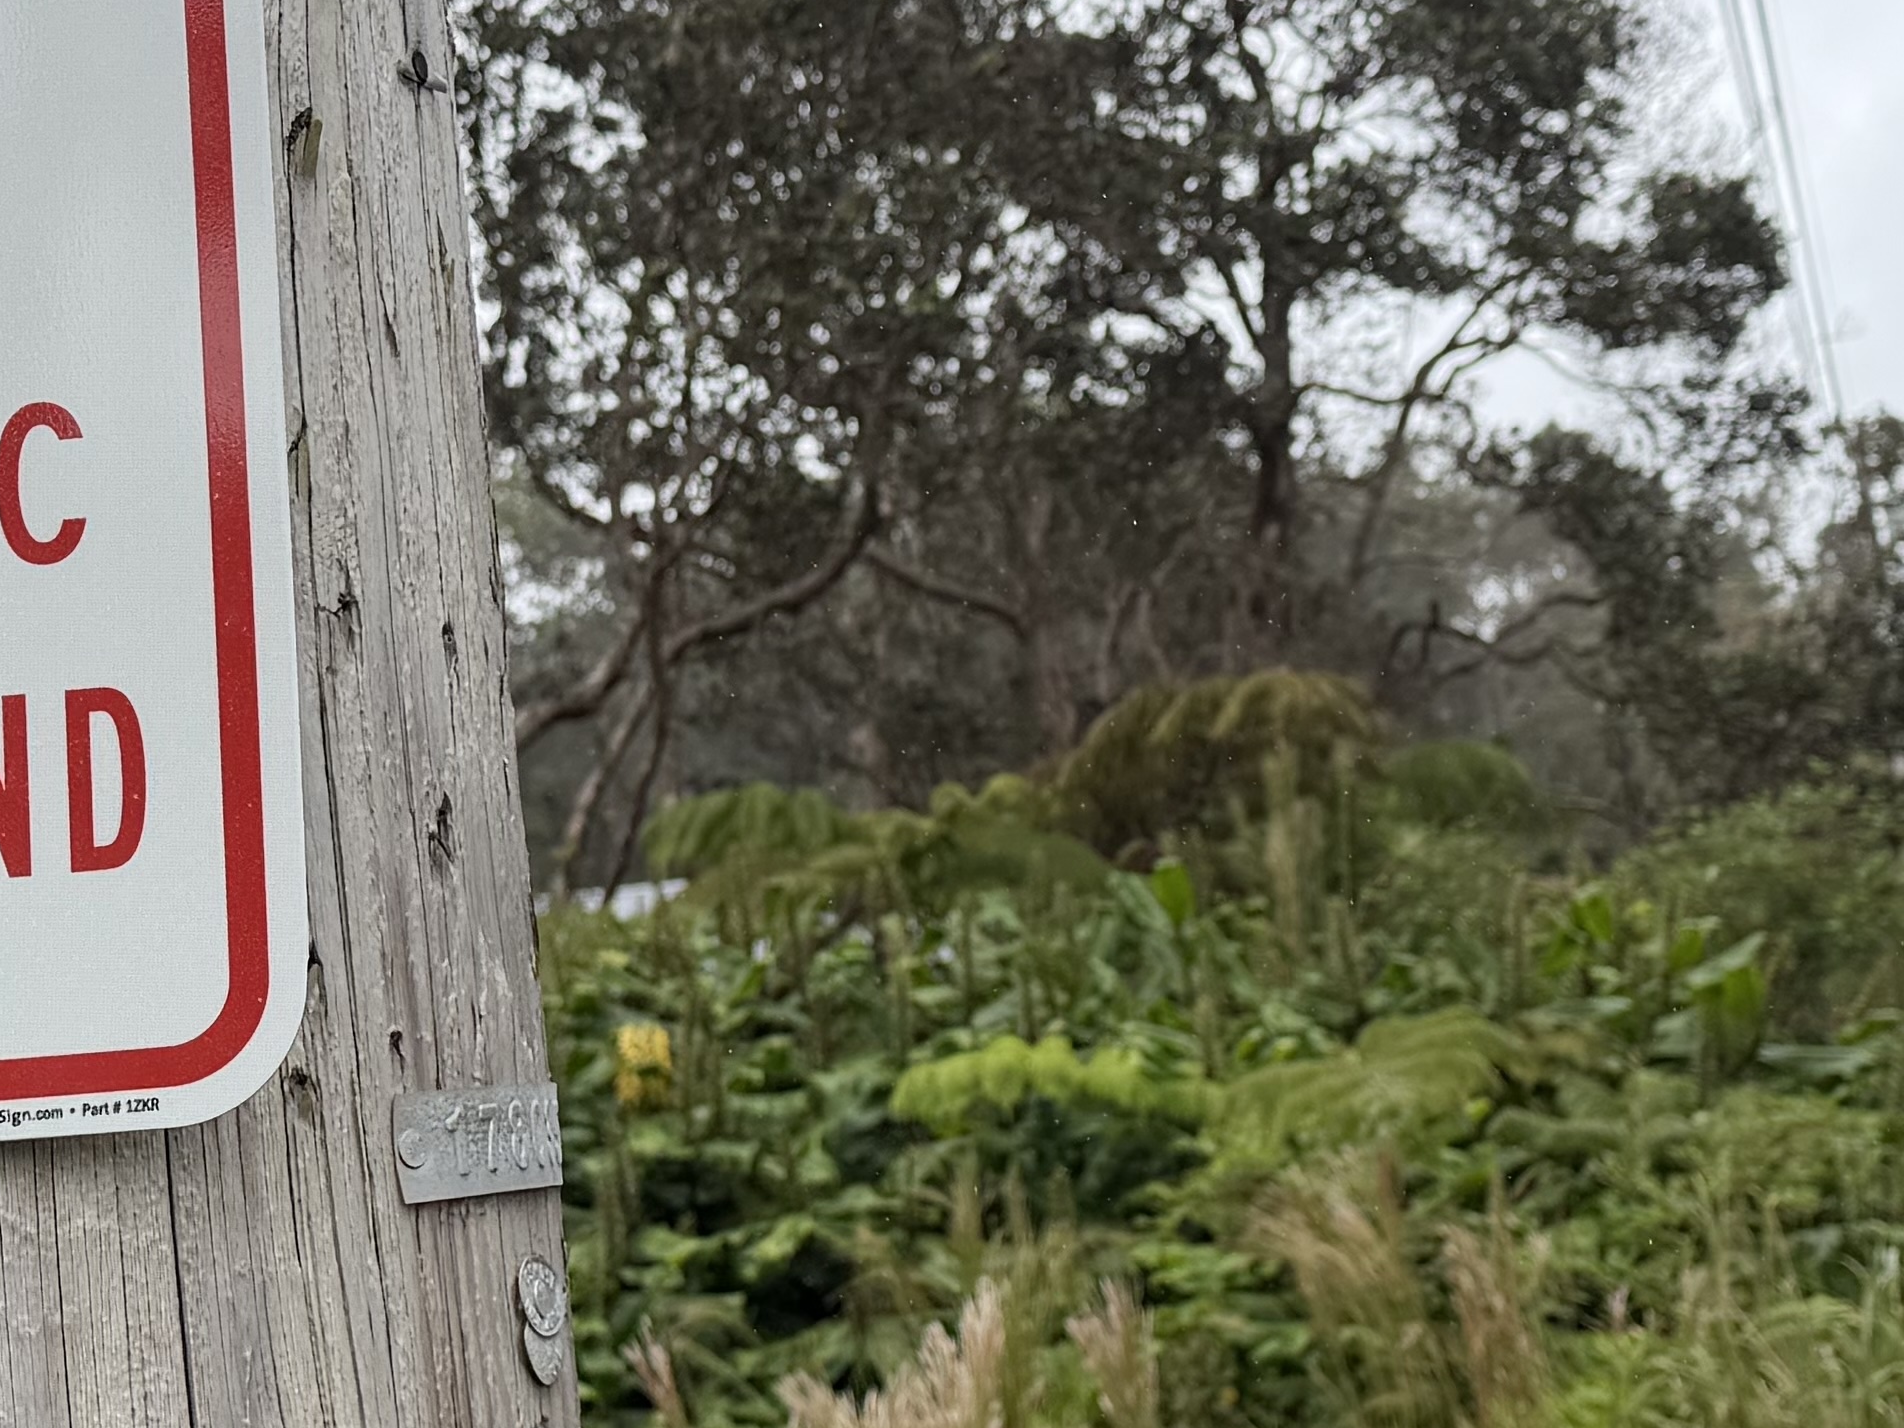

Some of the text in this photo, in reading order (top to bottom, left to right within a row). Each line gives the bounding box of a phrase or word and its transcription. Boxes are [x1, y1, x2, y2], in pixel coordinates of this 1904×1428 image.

[83, 1103, 109, 1116] Part
[113, 1101, 121, 1114] #
[126, 1098, 159, 1113] 1ZKR
